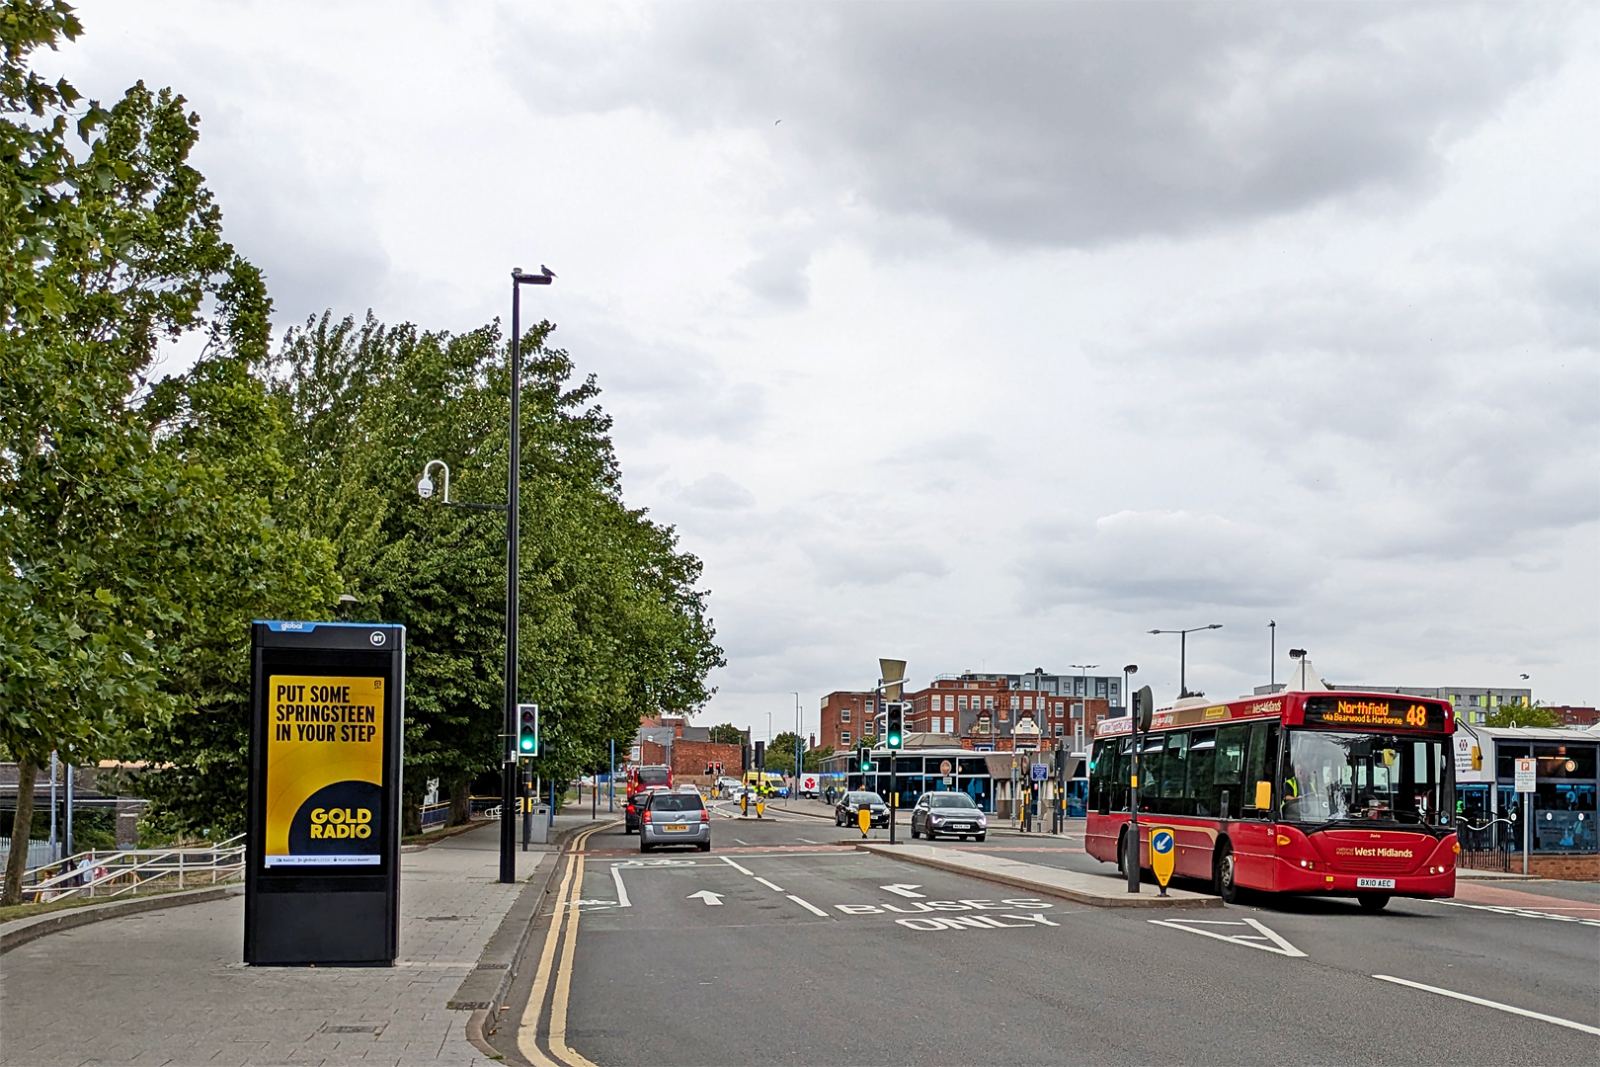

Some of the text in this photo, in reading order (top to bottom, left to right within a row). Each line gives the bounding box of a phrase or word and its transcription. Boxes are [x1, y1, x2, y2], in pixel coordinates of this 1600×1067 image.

[281, 622, 303, 631] global
[277, 685, 350, 703] PUT SOME
[276, 704, 375, 723] SPRINGSTEEN
[1338, 701, 1389, 715] Northfield
[1406, 705, 1426, 726] 48
[1322, 711, 1334, 721] via
[1334, 712, 1366, 723] Bearwood
[1372, 714, 1403, 725] Harborne
[276, 724, 376, 742] IN YOUR STEP
[310, 808, 372, 824] GOLD
[310, 824, 372, 839] RADIO
[1354, 847, 1413, 858] West Midlands
[834, 898, 1053, 914] BUSES
[894, 913, 1061, 931] ONLY
